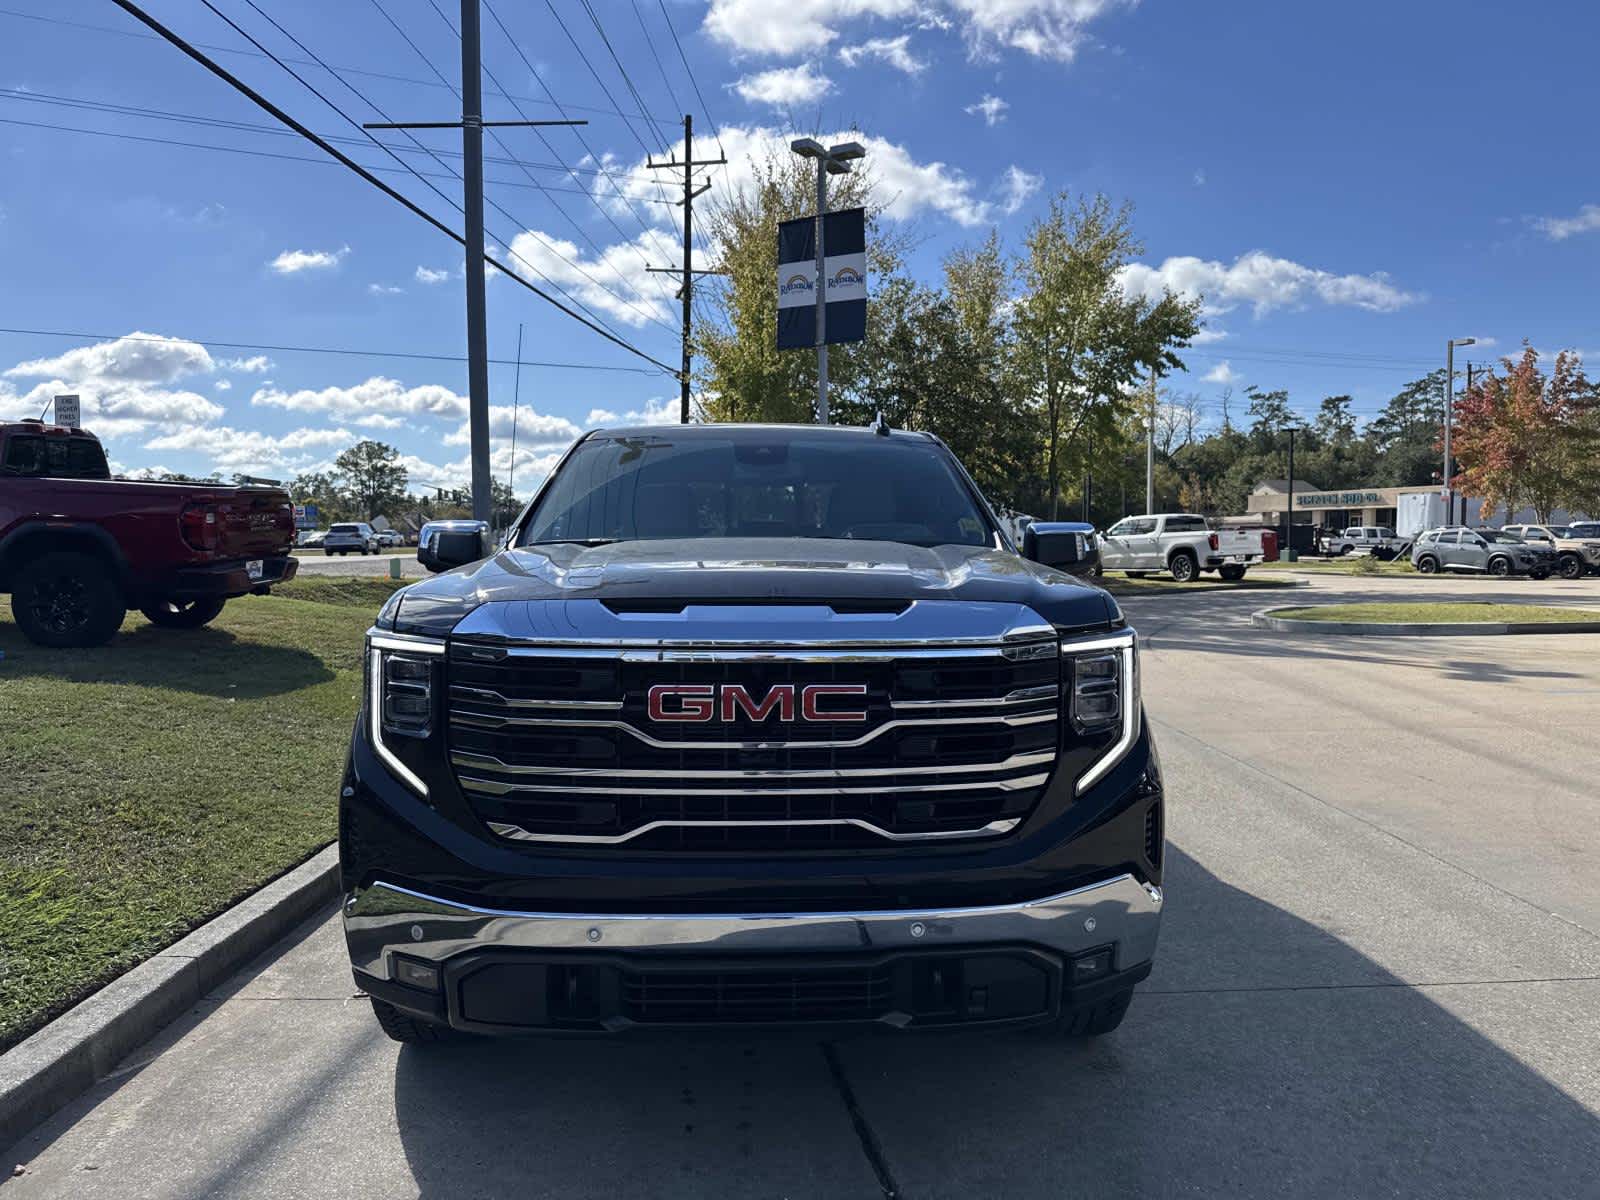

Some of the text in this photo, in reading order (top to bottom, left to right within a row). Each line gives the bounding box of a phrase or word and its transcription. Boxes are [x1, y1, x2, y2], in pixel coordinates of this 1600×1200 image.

[780, 281, 813, 295] RAINBOW
[828, 275, 864, 288] RAINBOW
[648, 684, 867, 721] GMC
